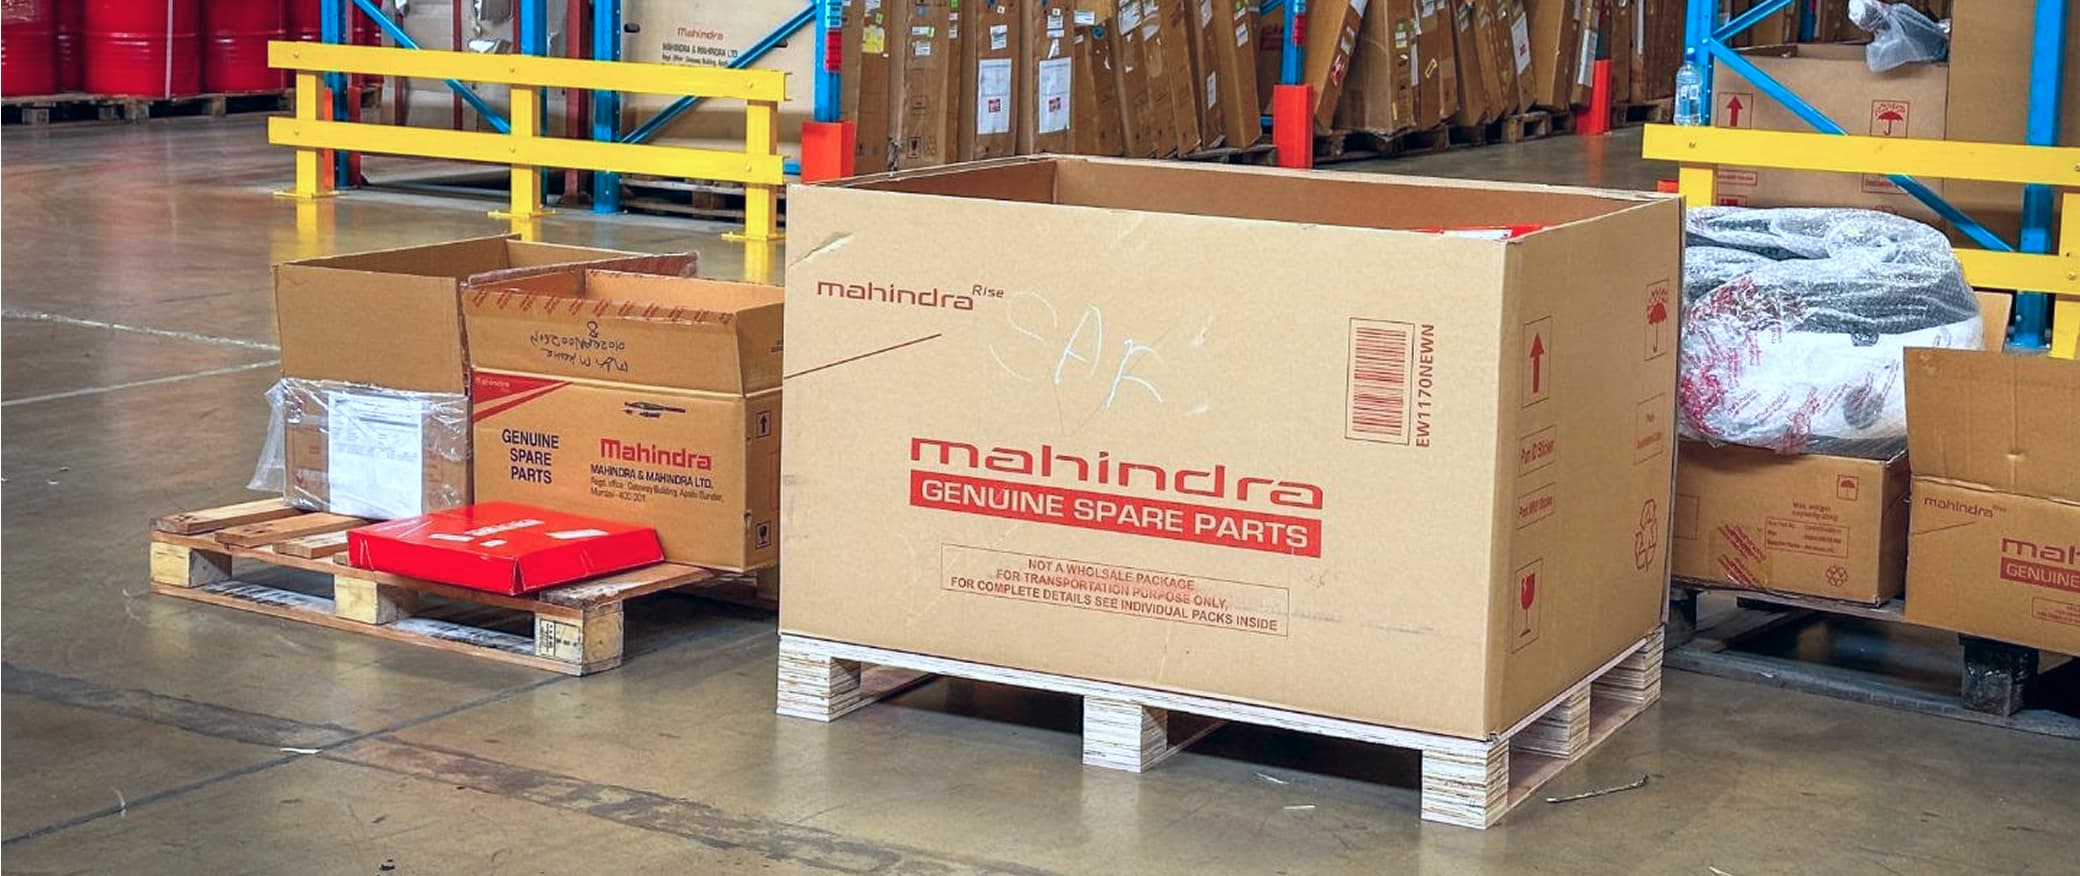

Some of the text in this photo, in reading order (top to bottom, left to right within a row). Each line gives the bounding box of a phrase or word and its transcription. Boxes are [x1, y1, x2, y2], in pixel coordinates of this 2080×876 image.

[816, 280, 1005, 311] mahindra Rise
[1415, 324, 1435, 448] EW1170NEWN
[502, 429, 559, 449] GENUINE
[600, 438, 712, 470] Mahindra
[510, 447, 552, 466] SPARE
[510, 465, 552, 484] PARTS
[591, 464, 714, 489] MAHINDRA & MAHINDRA LTD.
[911, 437, 1324, 509] mahindra
[921, 479, 1309, 549] GENUINE SPARE PARTS
[1924, 497, 1994, 518] mahindra
[996, 569, 1229, 610] FOR TRANSPORTATION PURPOSE ONLY,
[1028, 559, 1053, 571] NOT
[1055, 562, 1064, 572] A
[1135, 572, 1195, 590] PACKAGE
[2006, 563, 2080, 588] GENUINE
[951, 577, 1278, 631] FOR COMPLETE DETAILS SEE INDIVIDUAL PACKS INSIDE
